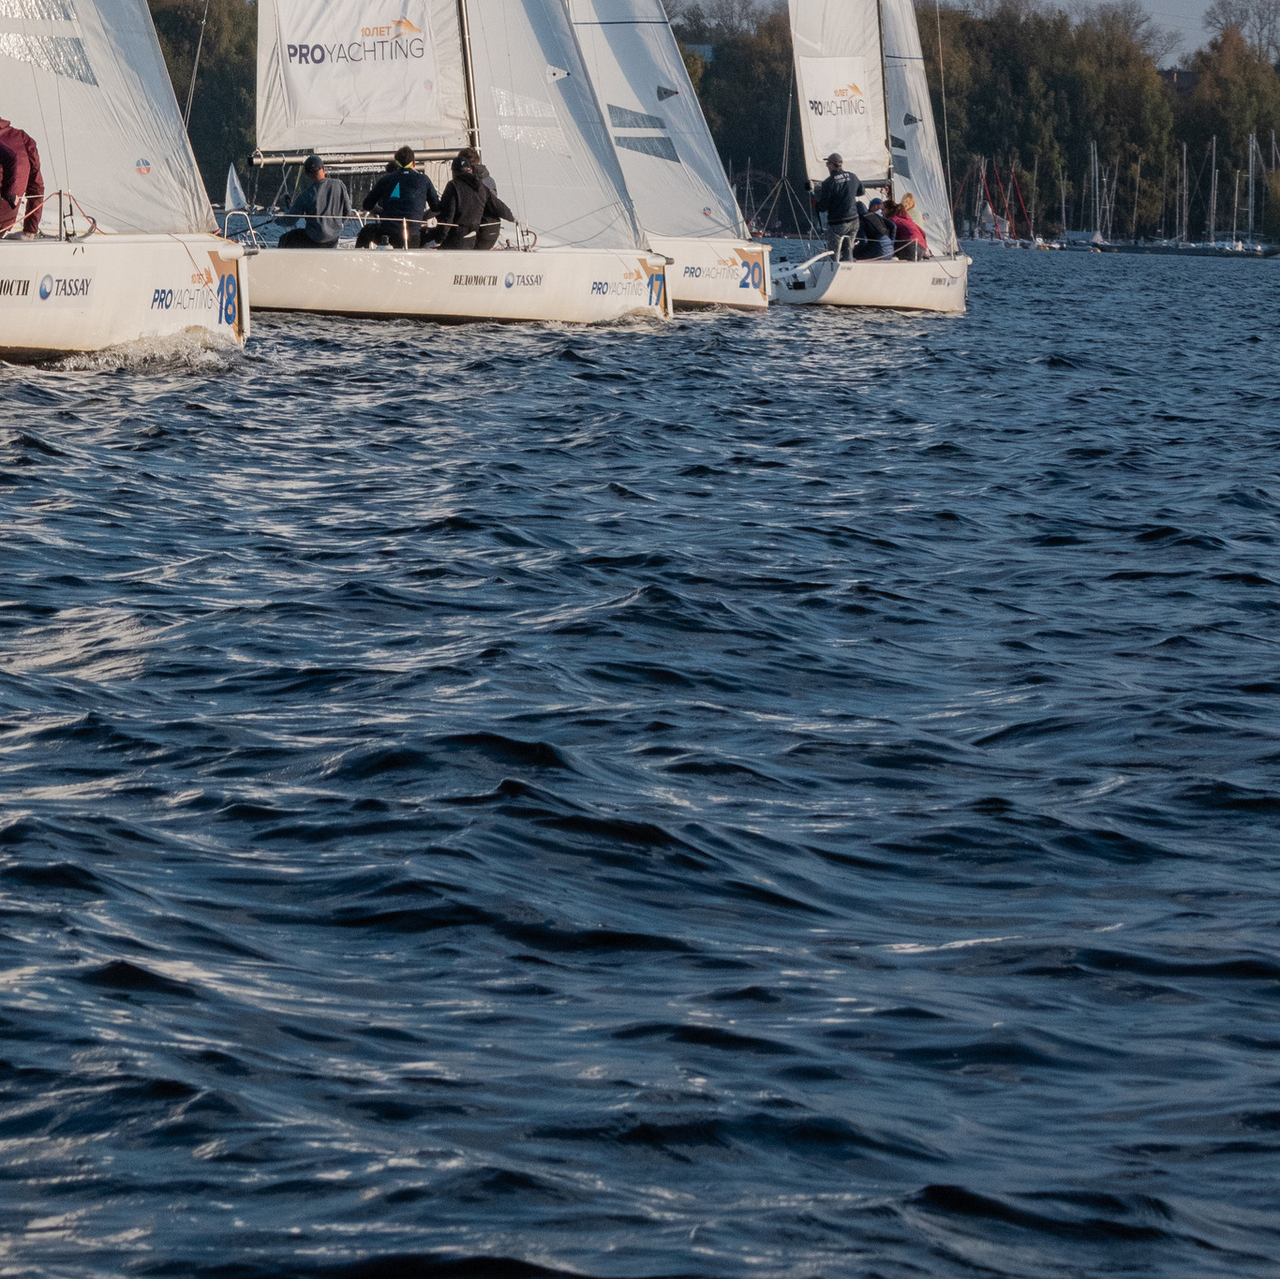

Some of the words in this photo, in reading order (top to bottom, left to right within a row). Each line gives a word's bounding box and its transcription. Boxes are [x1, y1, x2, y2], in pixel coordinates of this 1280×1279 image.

[286, 38, 424, 64] PROYACHTING
[55, 278, 92, 296] TASSAY
[515, 274, 544, 286] TASSAY
[739, 261, 763, 289] 20
[150, 288, 214, 309] PROYACHTING
[217, 273, 237, 325] 18
[646, 273, 665, 306] 17
